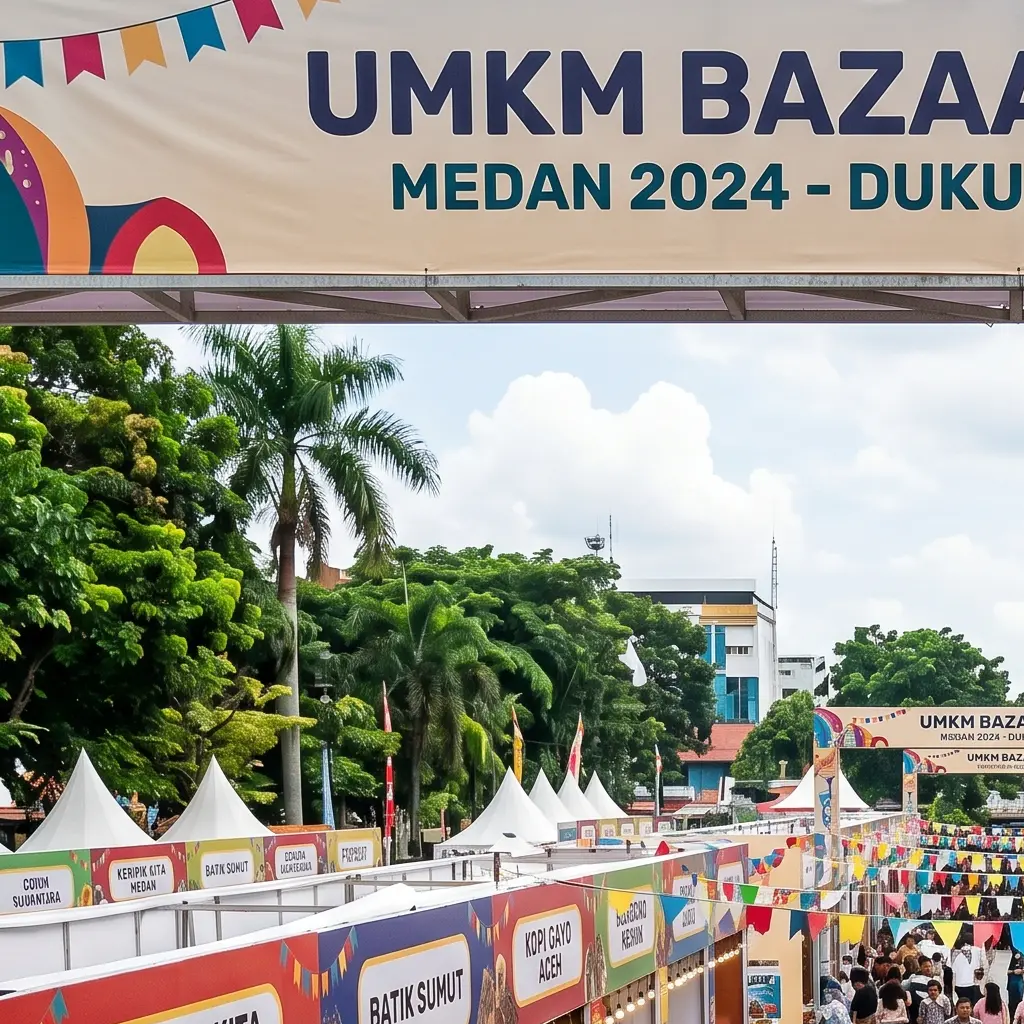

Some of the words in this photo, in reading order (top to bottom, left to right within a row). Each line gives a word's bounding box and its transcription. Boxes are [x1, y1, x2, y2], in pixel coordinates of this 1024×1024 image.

[308, 50, 644, 136] UMKM
[393, 163, 610, 210] MEDAN
[631, 162, 789, 211] 2024
[920, 714, 975, 729] UMKM
[977, 733, 1000, 741] 2024
[967, 753, 999, 762] UMKM
[117, 865, 148, 880] KERIPIK
[130, 880, 157, 894] MEDAN
[525, 927, 547, 958] KOPI
[549, 920, 572, 951] GAYO
[417, 968, 464, 1014] SUMUT
